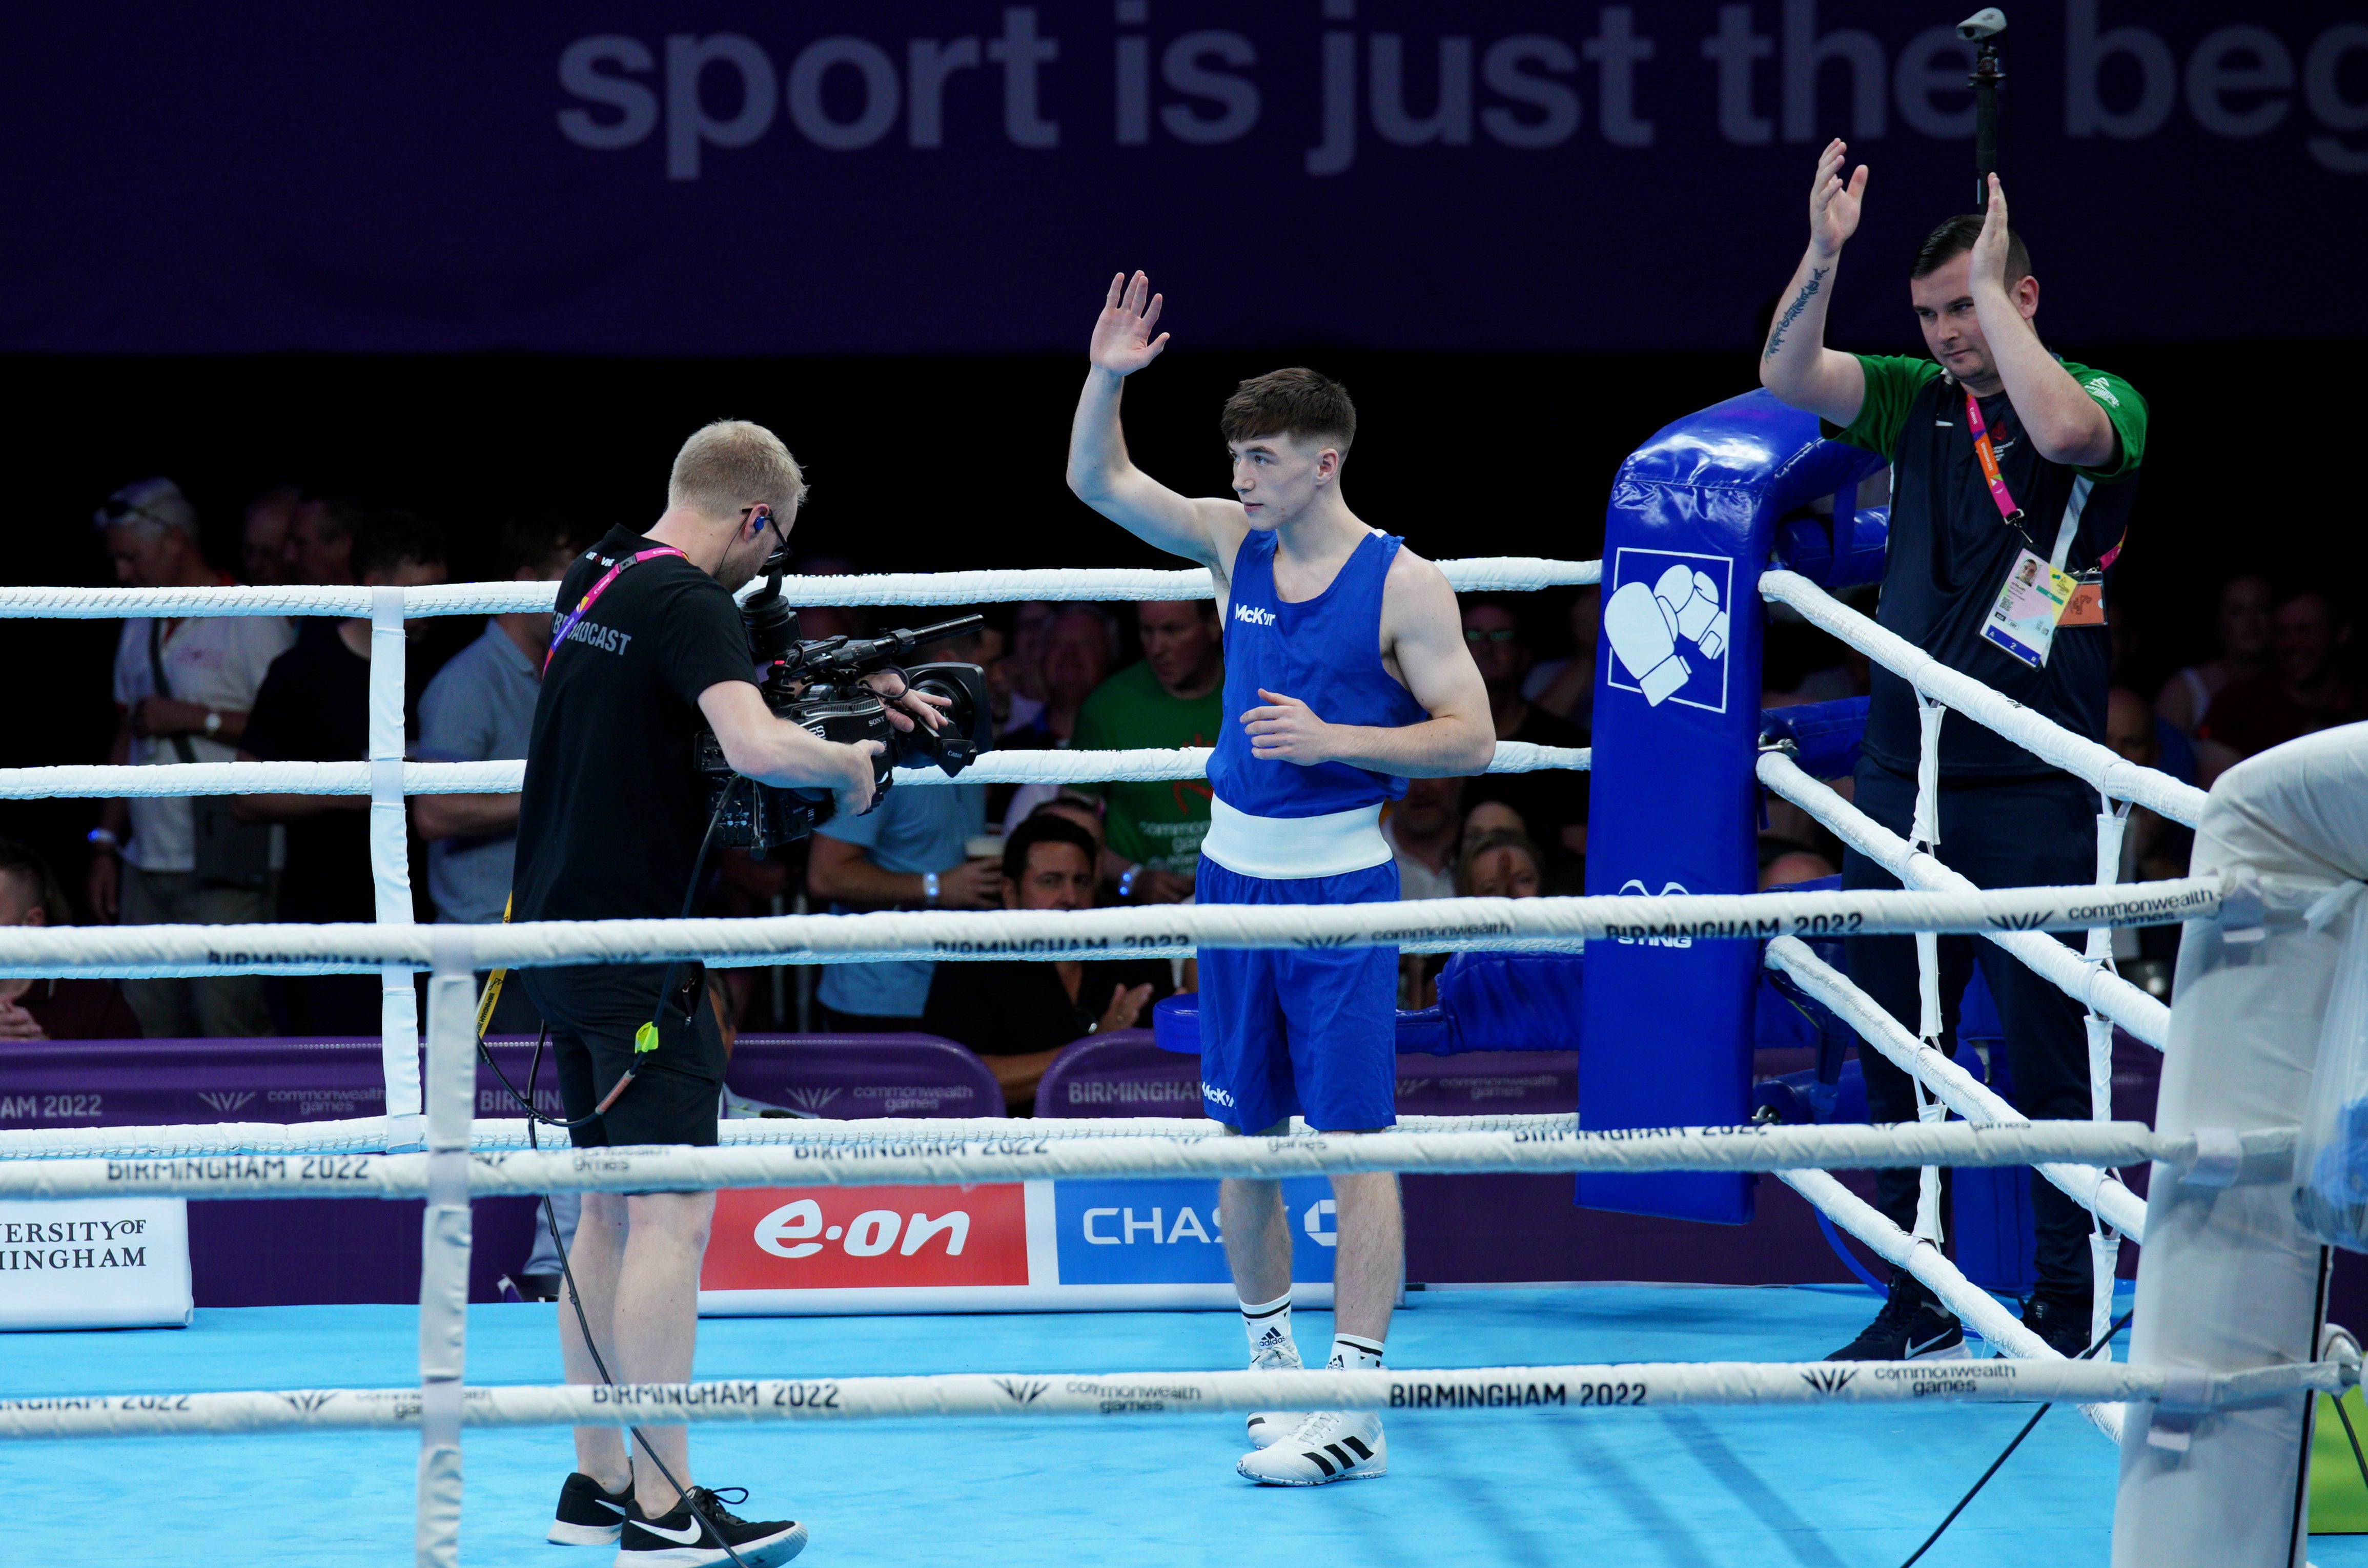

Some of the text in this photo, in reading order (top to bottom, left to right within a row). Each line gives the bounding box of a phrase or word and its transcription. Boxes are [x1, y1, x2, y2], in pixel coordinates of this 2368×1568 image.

[557, 8, 1059, 181] sport
[1116, 0, 1260, 144] is
[1307, 0, 1654, 175] just
[1701, 0, 1978, 146] the
[868, 716, 885, 727] SONY
[2069, 889, 2214, 920] commonwealth
[1794, 912, 1863, 935] 2022
[853, 1085, 973, 1101] commonwealth
[44, 1094, 102, 1118] 2022
[300, 1101, 355, 1115] games
[885, 1097, 939, 1111] games
[108, 1156, 370, 1181] BIRMINGHAM 2022
[0, 1222, 121, 1243] ERSITY
[1259, 1335, 1287, 1347] adidas
[1874, 1364, 2016, 1380] commonwealth
[593, 1382, 840, 1408] BIRMINGHAM 2022
[1067, 1380, 1201, 1402] commonwealth
[1389, 1383, 1646, 1409] BIRMINGHAM 2022
[1912, 1377, 1977, 1396] games
[1099, 1397, 1165, 1414] games
